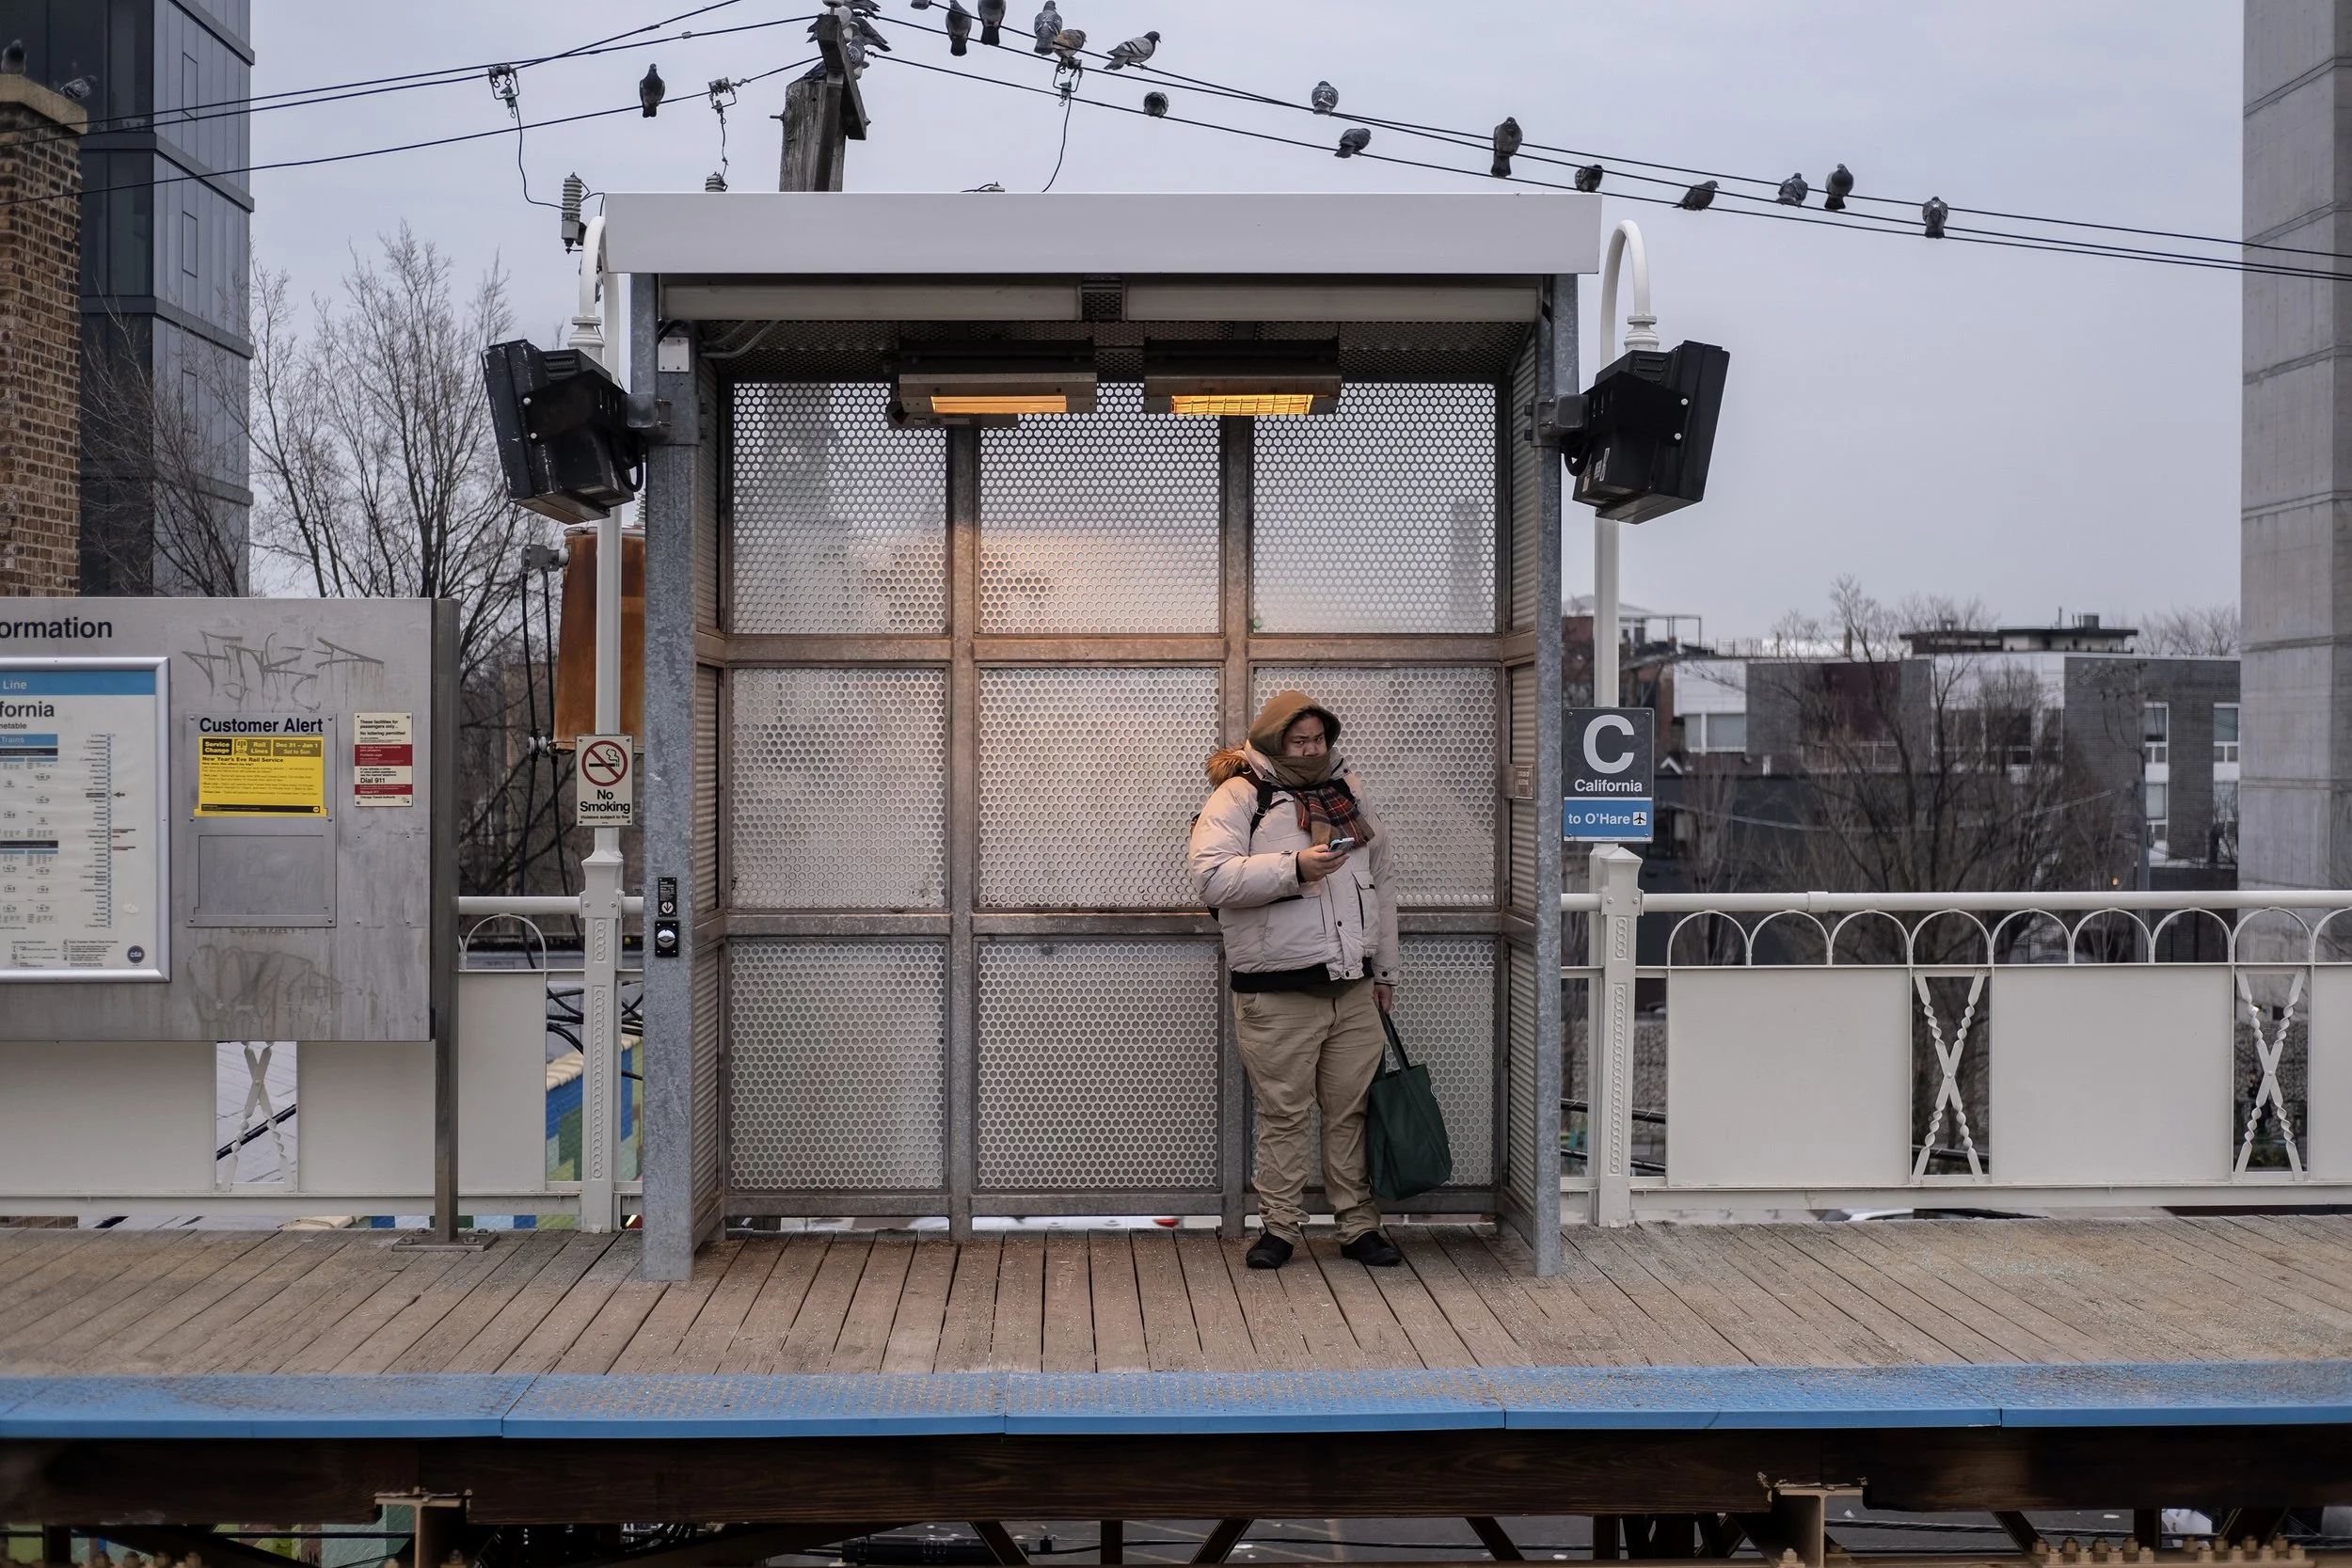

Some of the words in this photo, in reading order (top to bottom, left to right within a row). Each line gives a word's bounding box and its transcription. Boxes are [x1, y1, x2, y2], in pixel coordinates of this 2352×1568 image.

[0, 616, 113, 639] ormation
[3, 680, 27, 689] Line
[199, 718, 278, 732] Customer
[283, 718, 323, 732] Alert
[1583, 715, 1635, 774] C
[1574, 779, 1643, 792] California
[597, 789, 614, 800] No
[580, 801, 630, 814] Smoking
[1568, 813, 1581, 824] to
